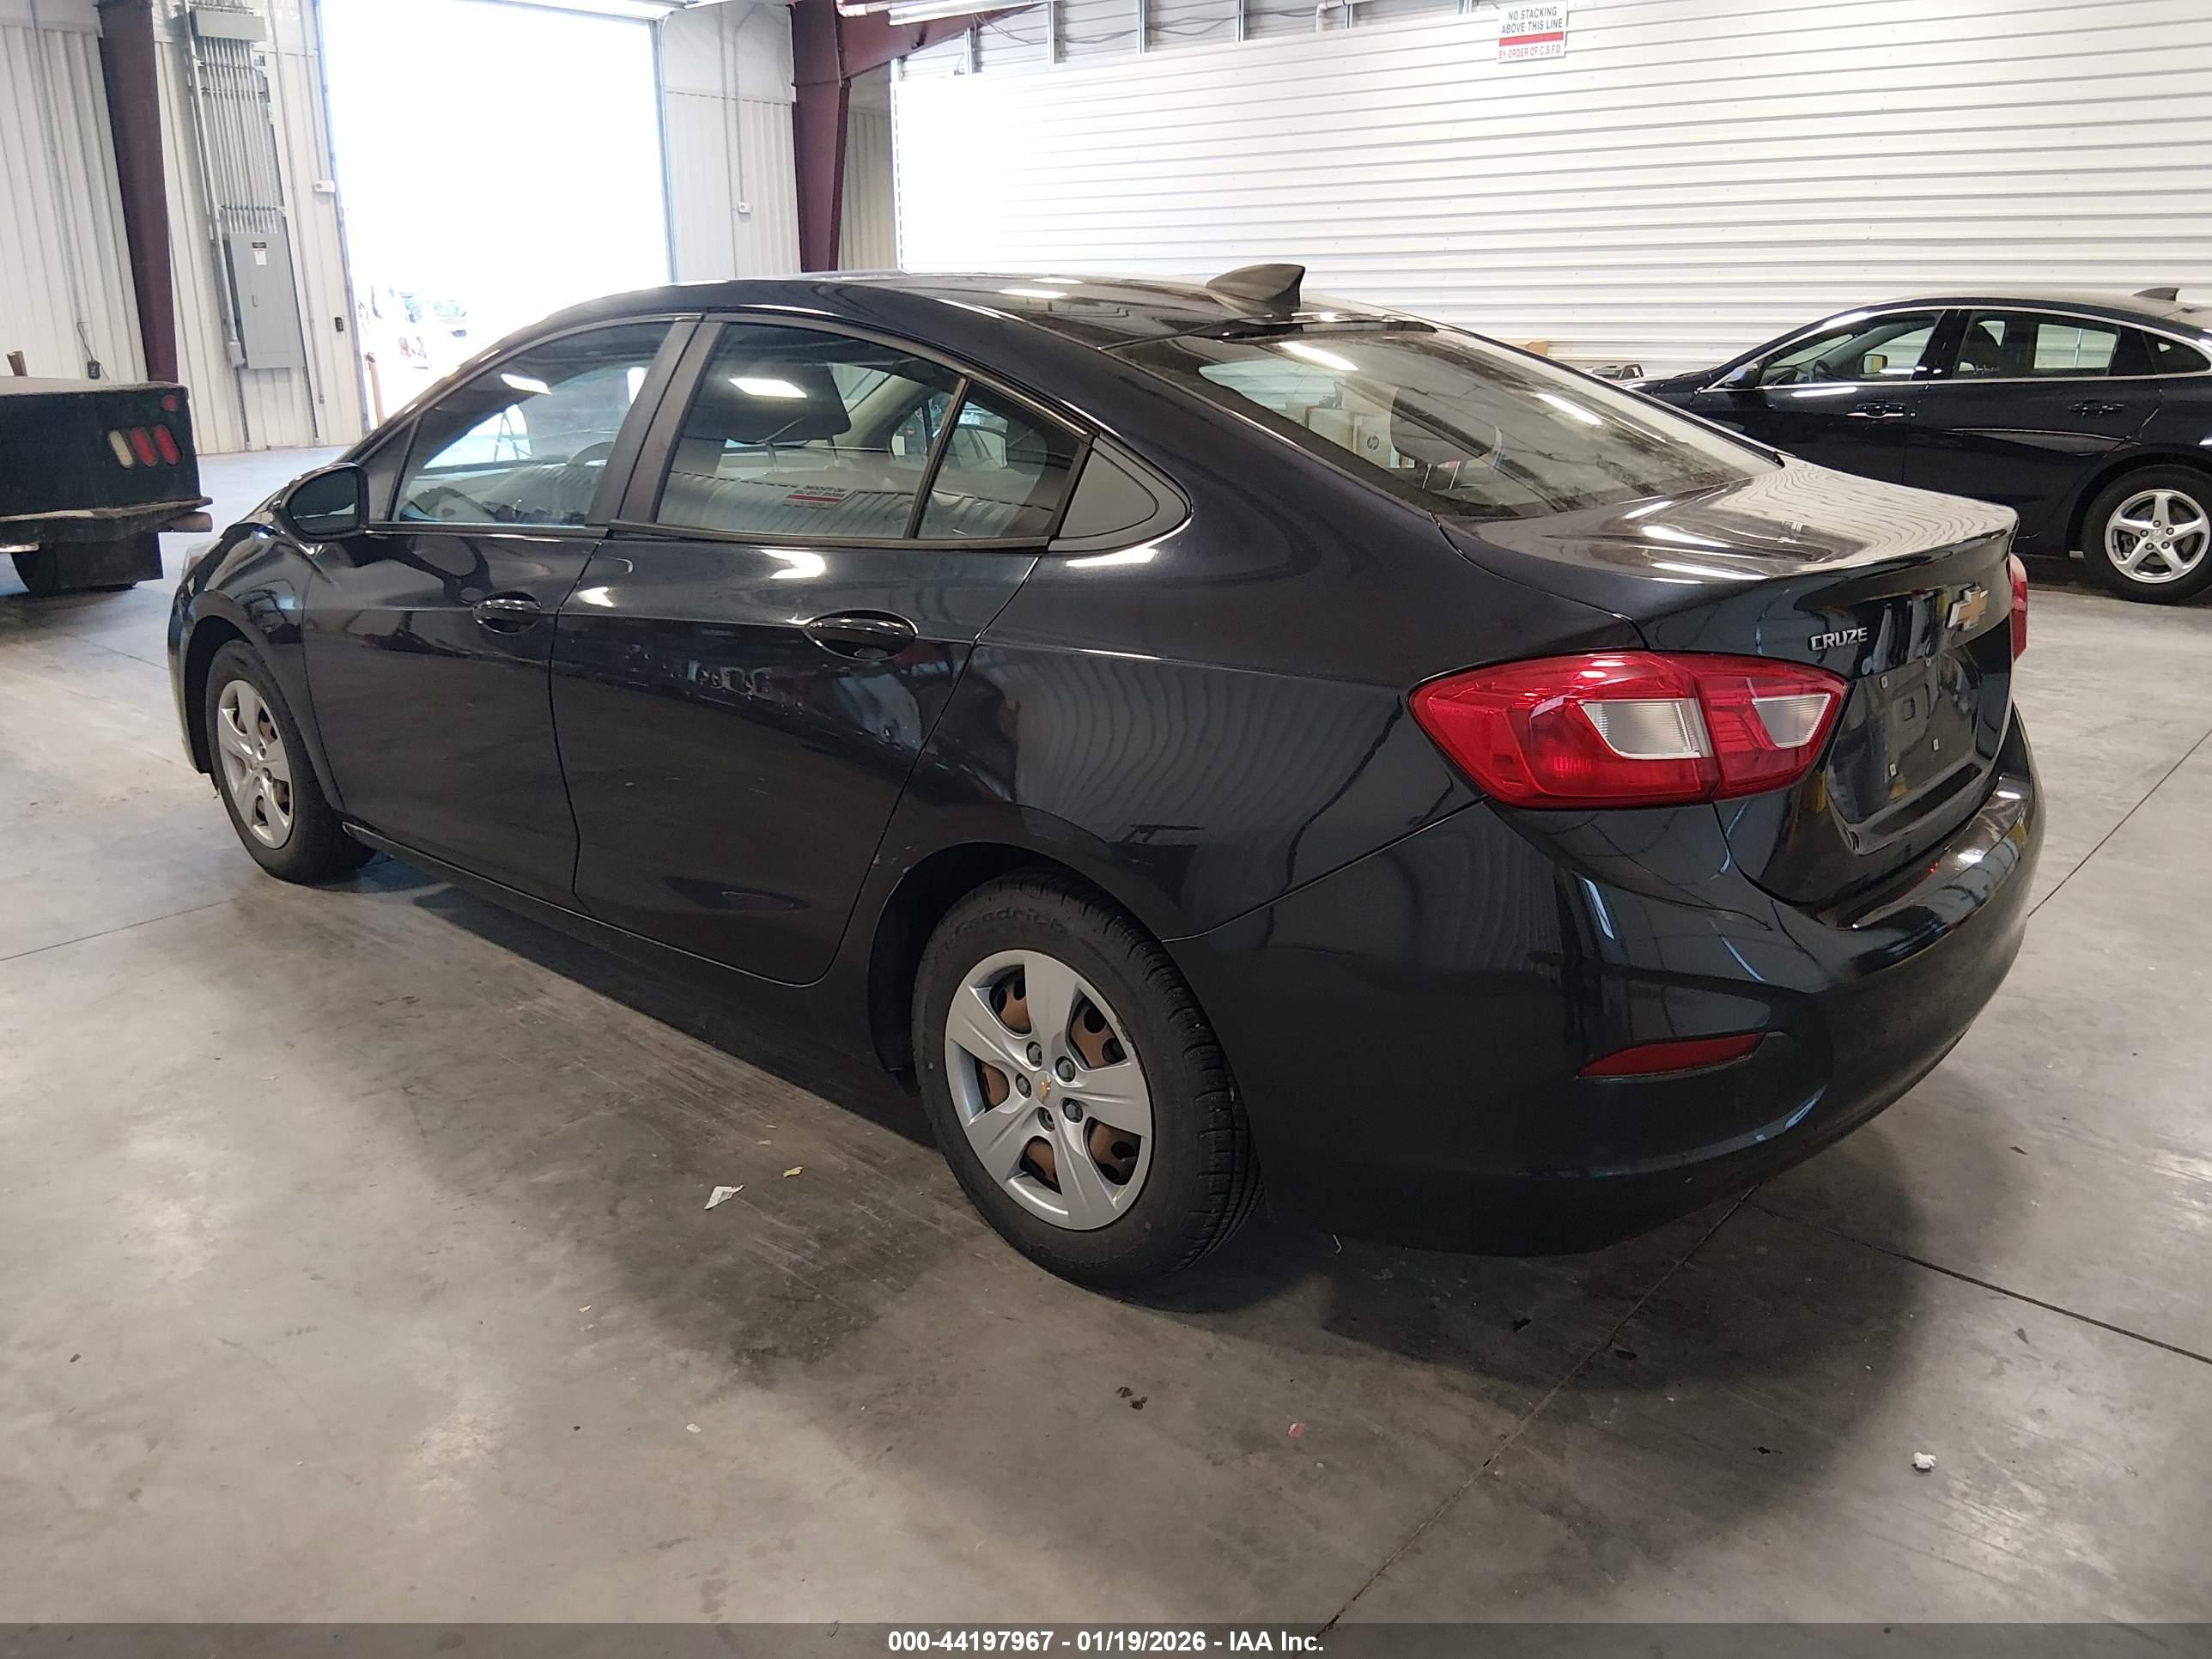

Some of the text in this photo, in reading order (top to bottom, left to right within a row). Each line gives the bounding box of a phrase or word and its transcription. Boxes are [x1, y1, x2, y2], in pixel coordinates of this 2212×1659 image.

[1509, 6, 1558, 21] NO STACKING
[1501, 18, 1563, 33] ABOVE THIS LINE
[1809, 627, 1869, 651] CRUZE
